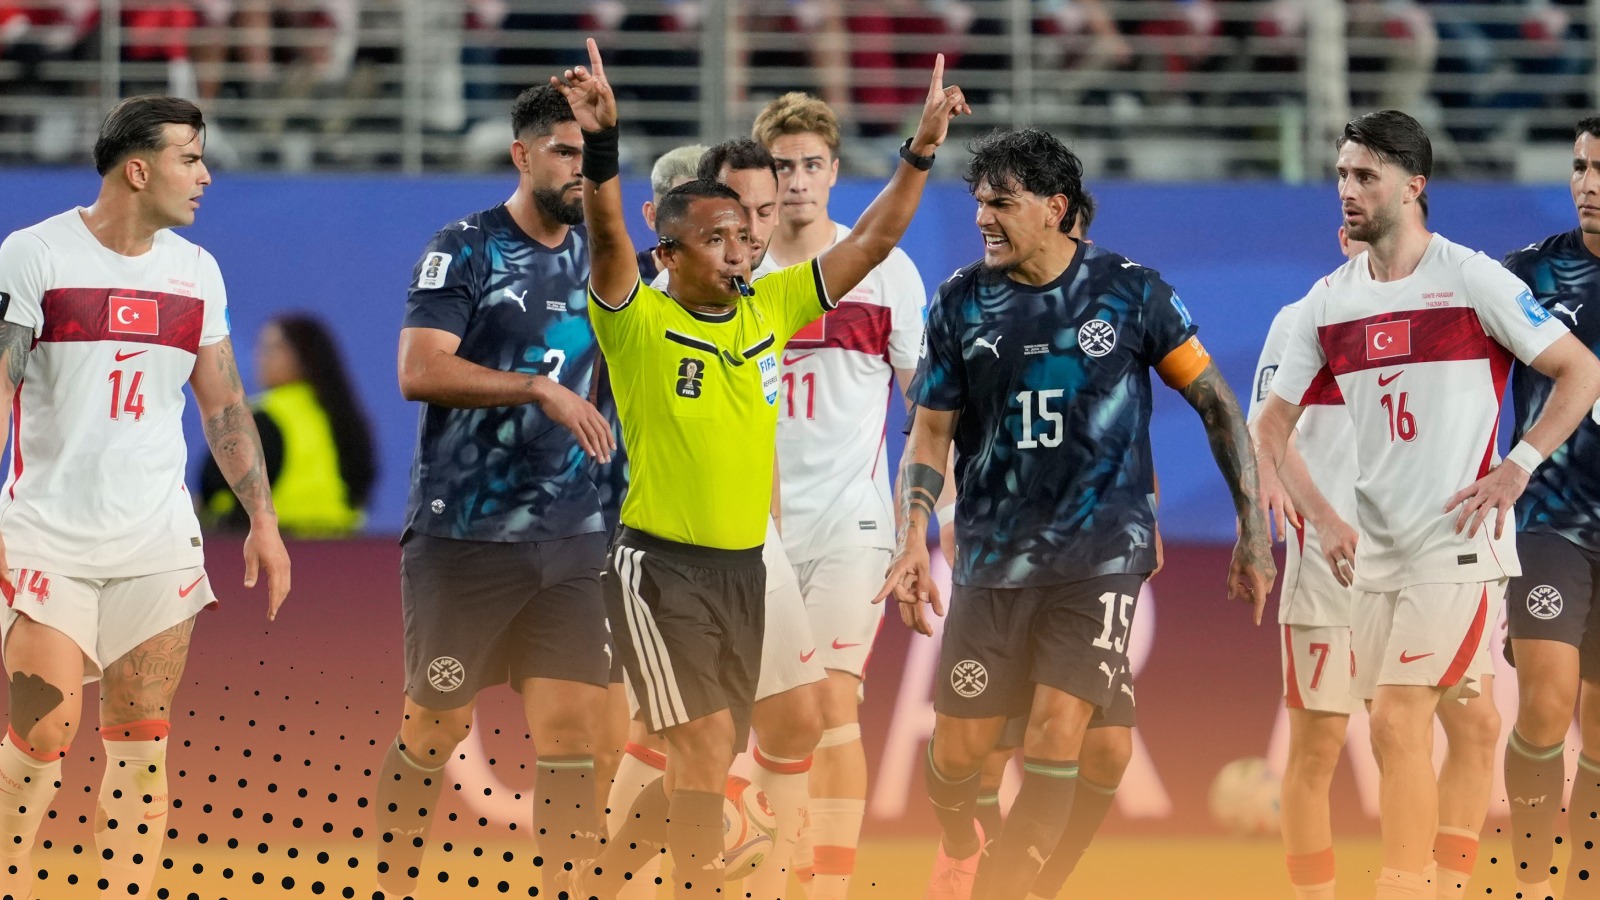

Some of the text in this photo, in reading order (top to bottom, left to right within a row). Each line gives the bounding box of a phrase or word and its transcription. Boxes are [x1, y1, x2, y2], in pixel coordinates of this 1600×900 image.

[760, 356, 776, 373] FIFA
[763, 375, 778, 388] REFEREE
[108, 370, 145, 421] 14
[781, 372, 816, 420] 11
[1016, 389, 1065, 449] 15
[1380, 391, 1418, 442] 16
[15, 568, 50, 605] 14
[1092, 591, 1134, 654] 15
[1309, 642, 1330, 691] 7
